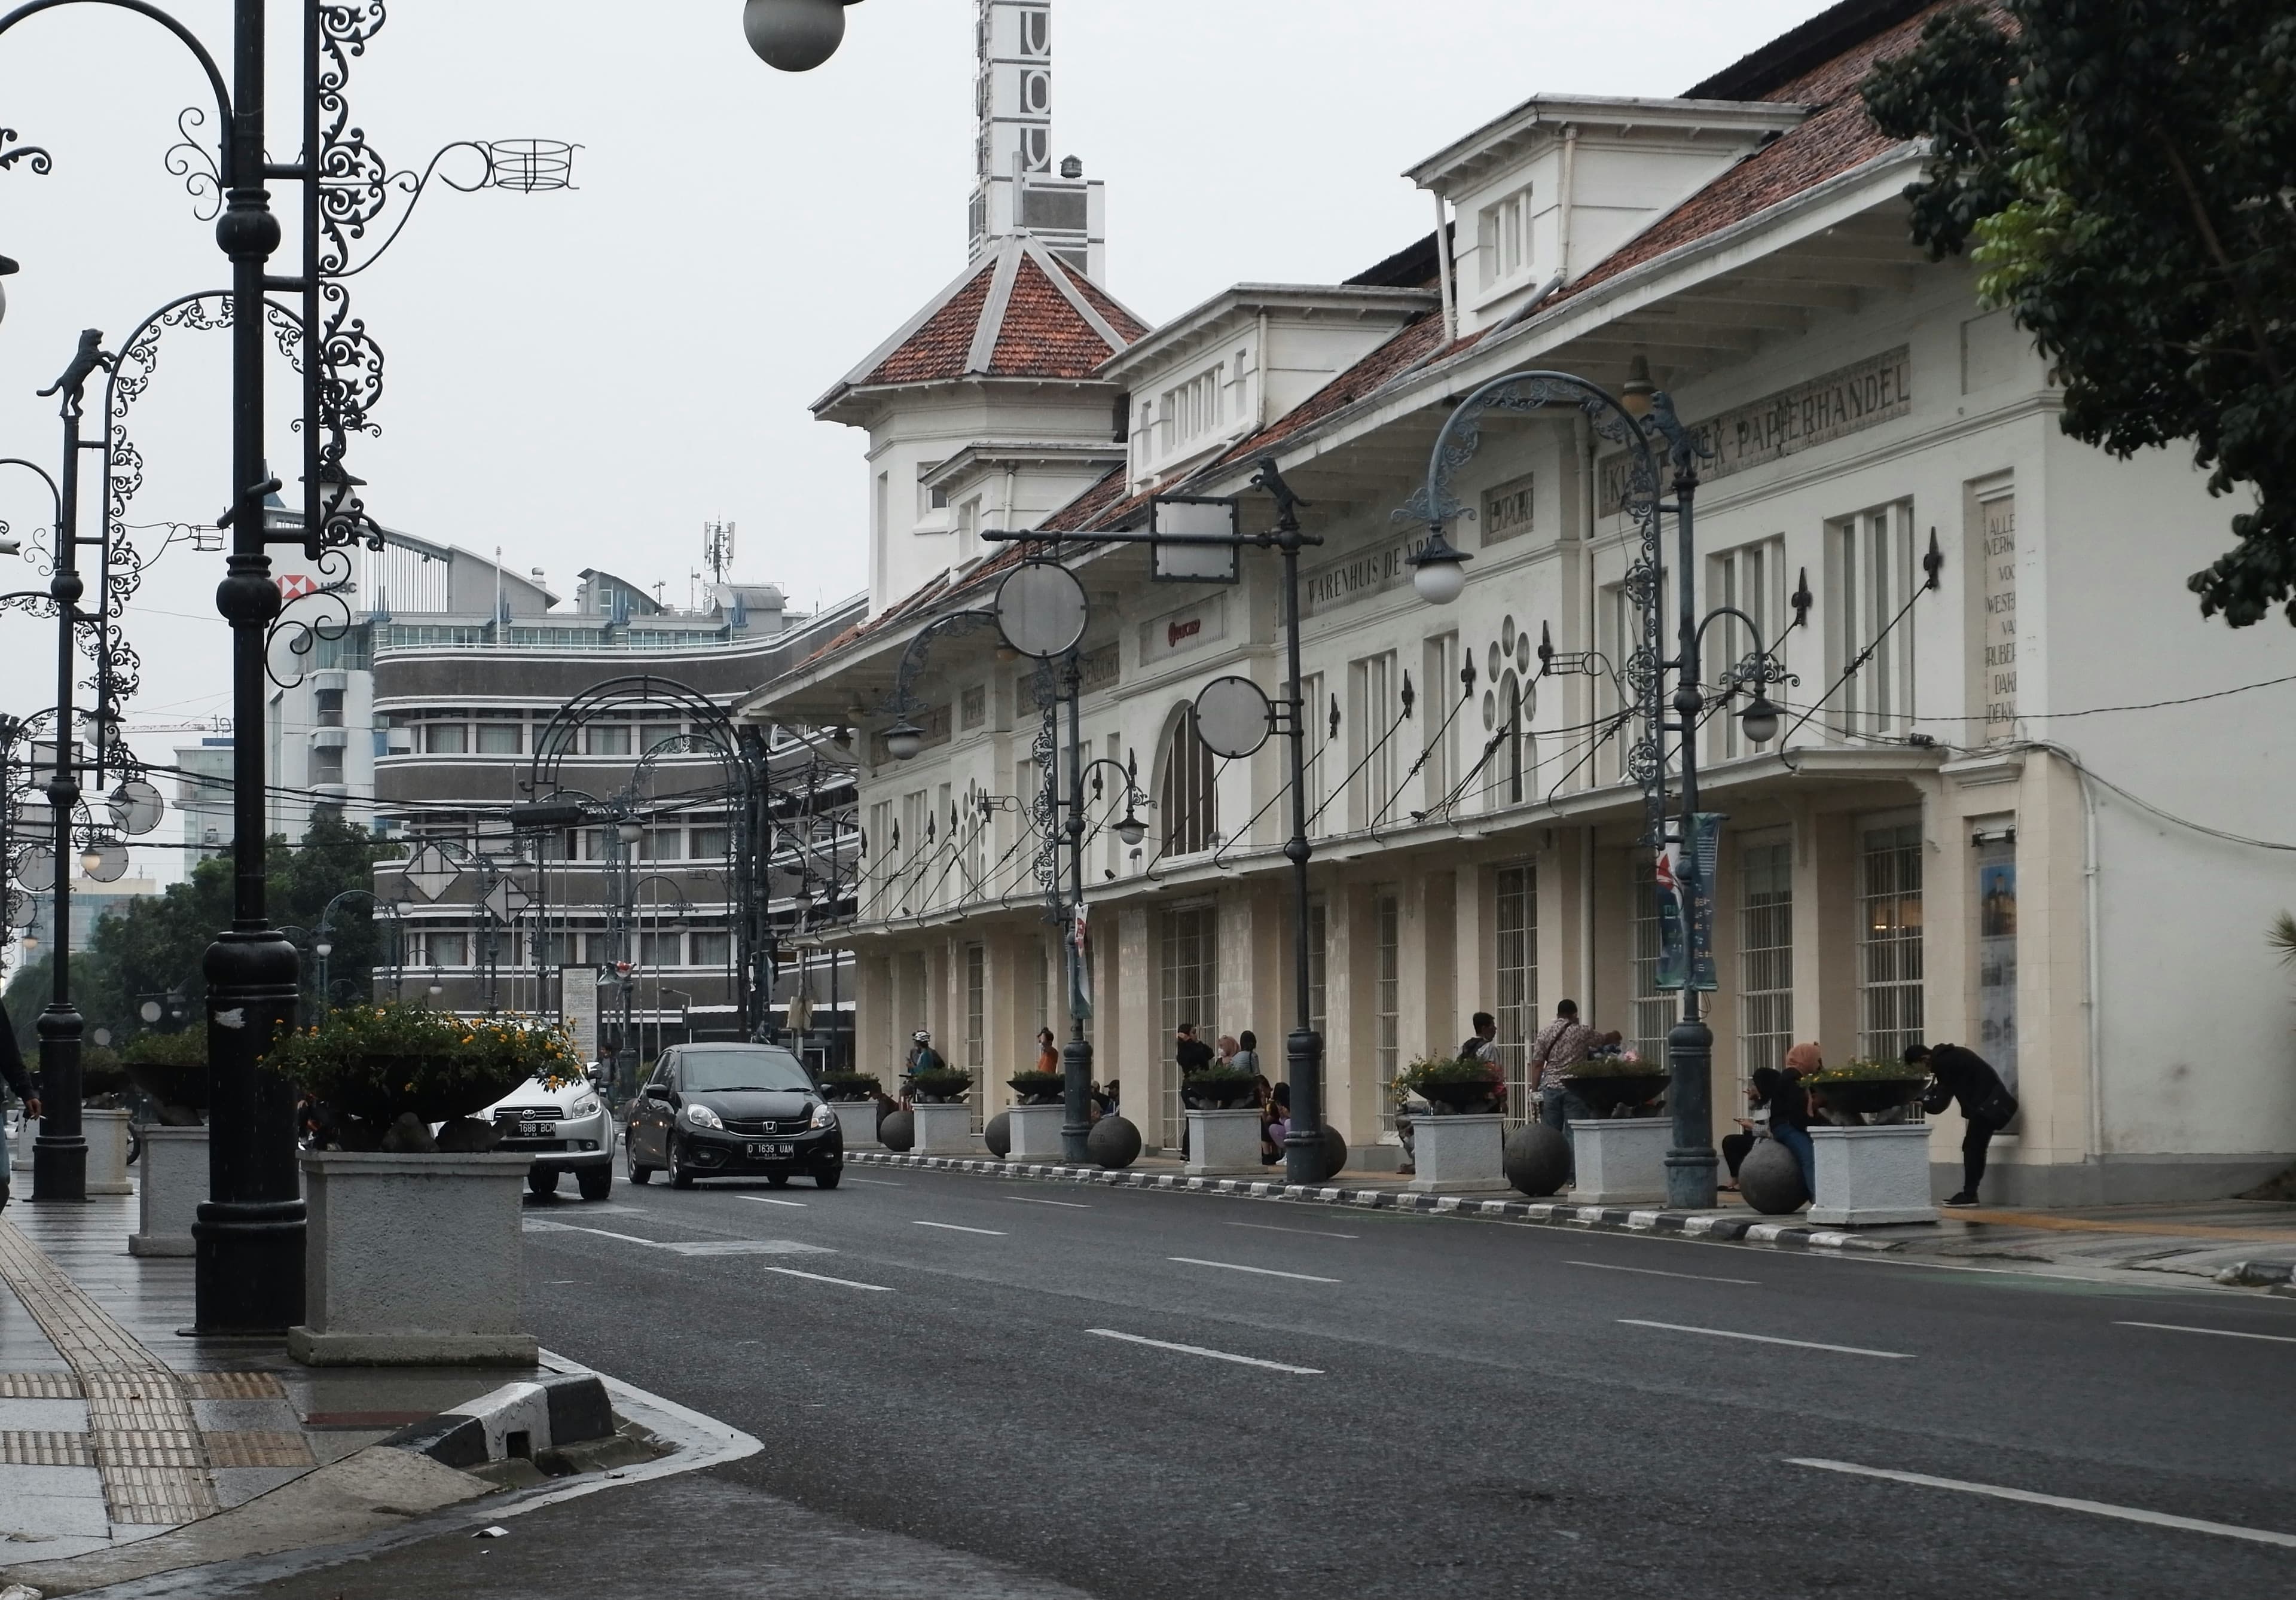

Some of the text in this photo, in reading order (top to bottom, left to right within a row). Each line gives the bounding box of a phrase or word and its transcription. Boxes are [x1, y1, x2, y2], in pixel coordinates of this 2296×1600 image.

[1990, 514, 2016, 536] ALLE
[1308, 556, 1378, 604] WARENHUIS
[1384, 547, 1401, 579] DE
[541, 1123, 555, 1132] BCM
[749, 1144, 793, 1153] D 1639 UAM
